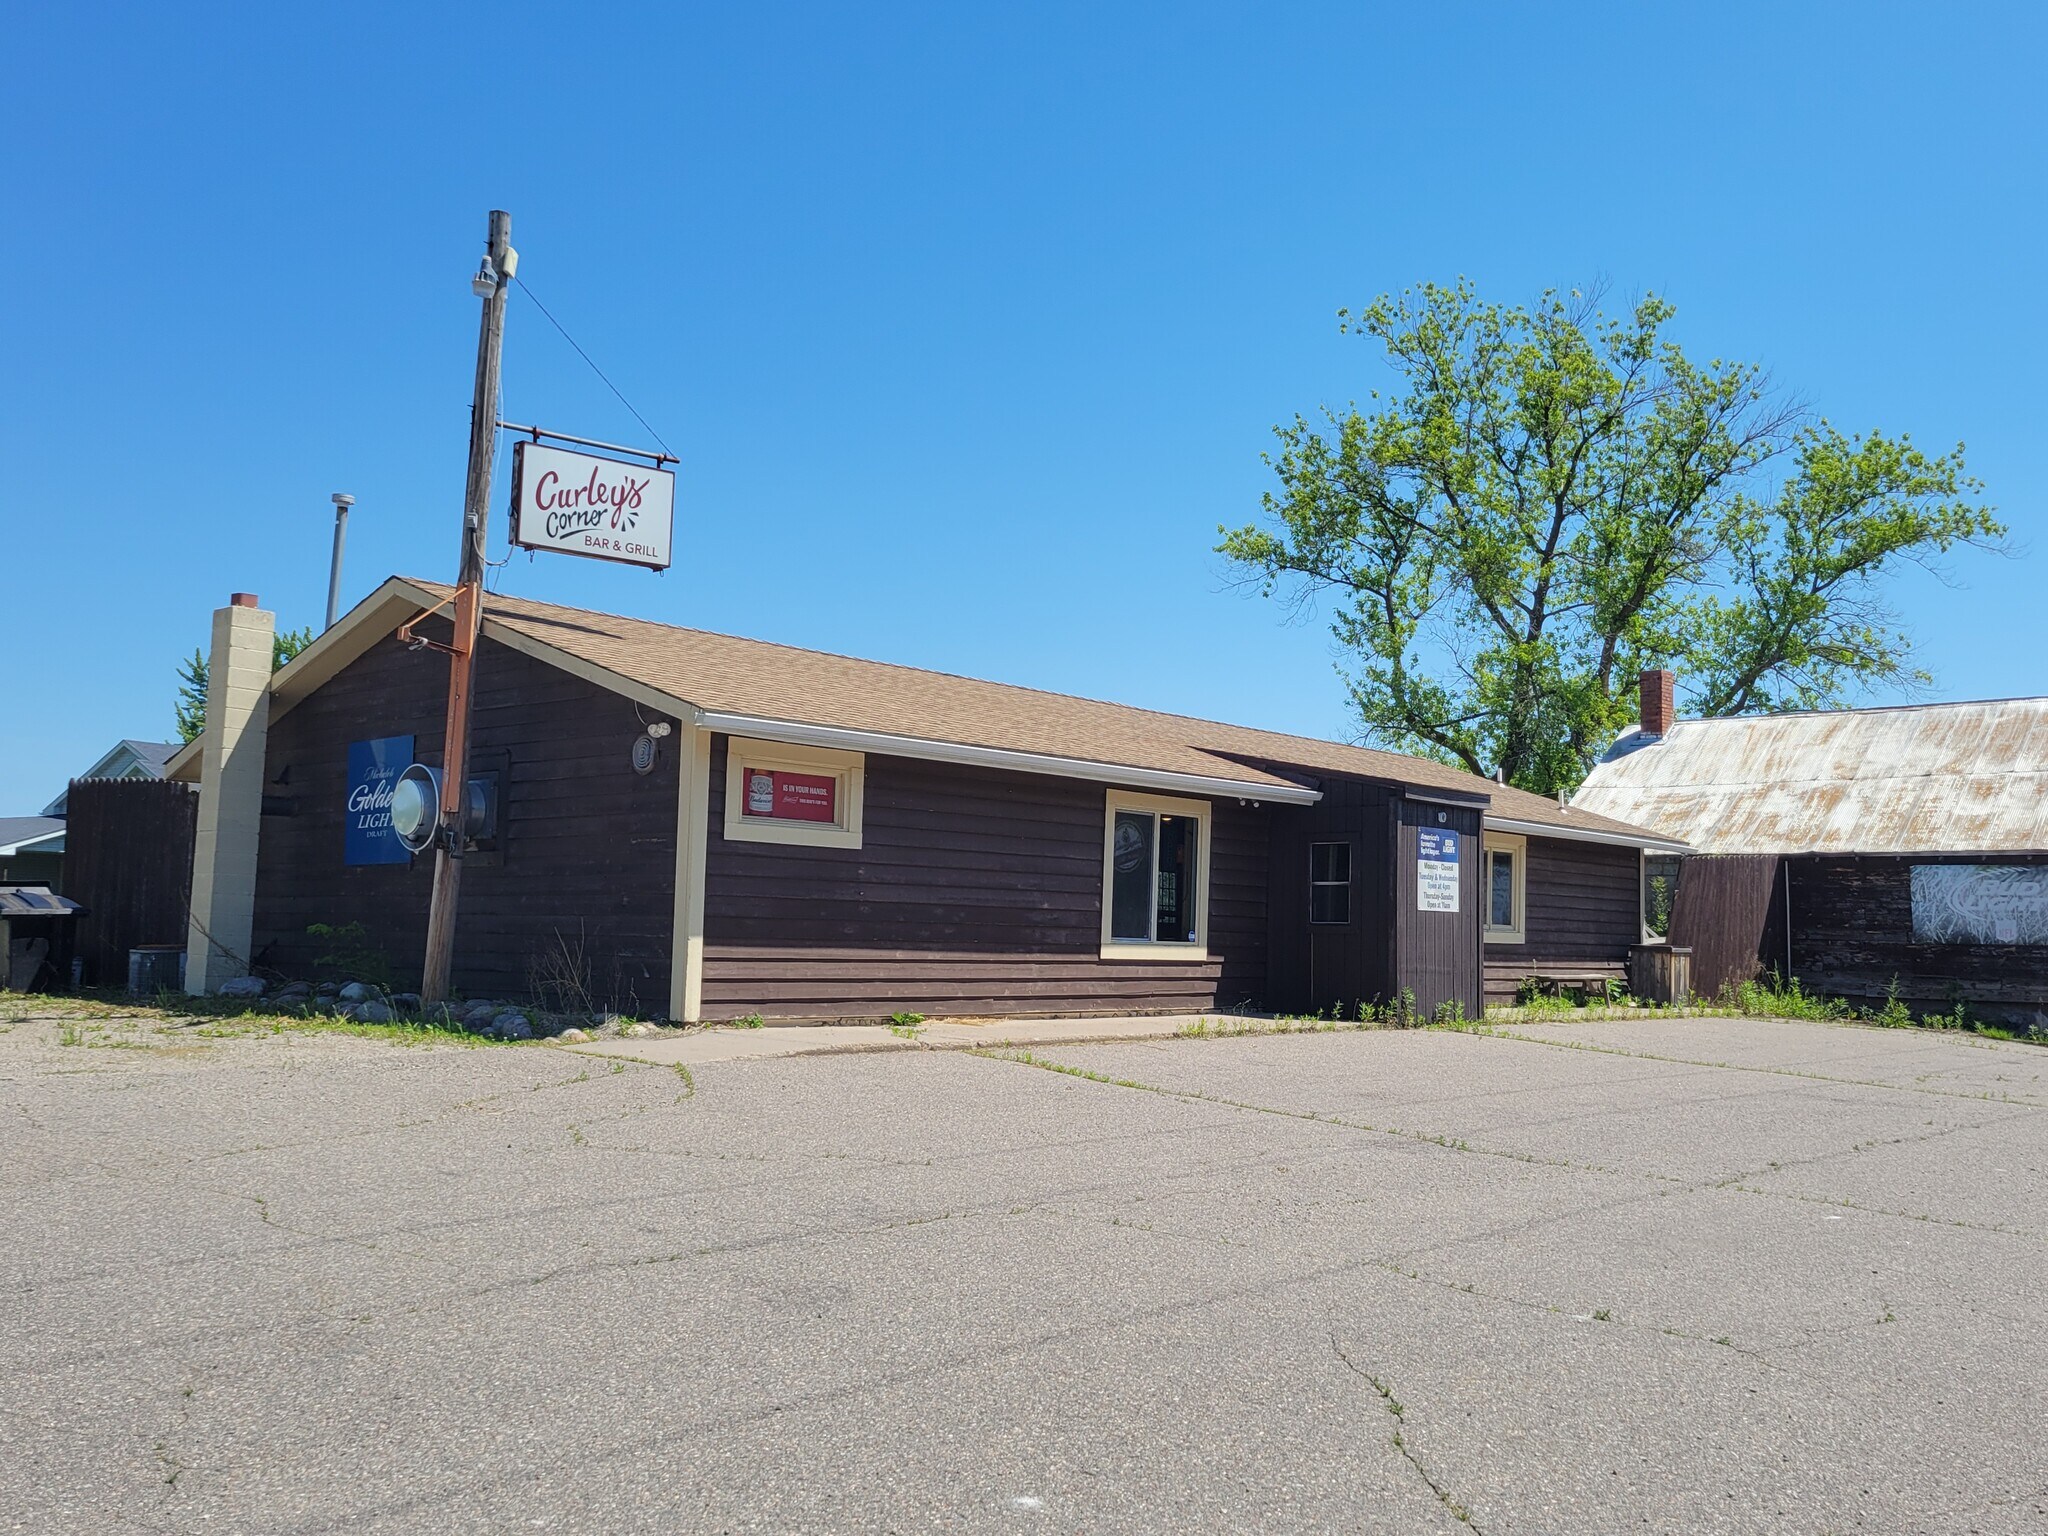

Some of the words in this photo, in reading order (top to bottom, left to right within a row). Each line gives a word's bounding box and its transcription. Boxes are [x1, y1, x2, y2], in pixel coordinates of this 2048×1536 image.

[536, 466, 650, 529] Curley's
[584, 536, 610, 550] BAR
[612, 540, 622, 552] &
[626, 542, 658, 558] GRILL
[348, 780, 394, 812] Golde
[795, 786, 809, 794] YOUR
[1424, 862, 1438, 871] Monday
[1441, 863, 1454, 871] Closed
[1419, 872, 1434, 881] Tuesday
